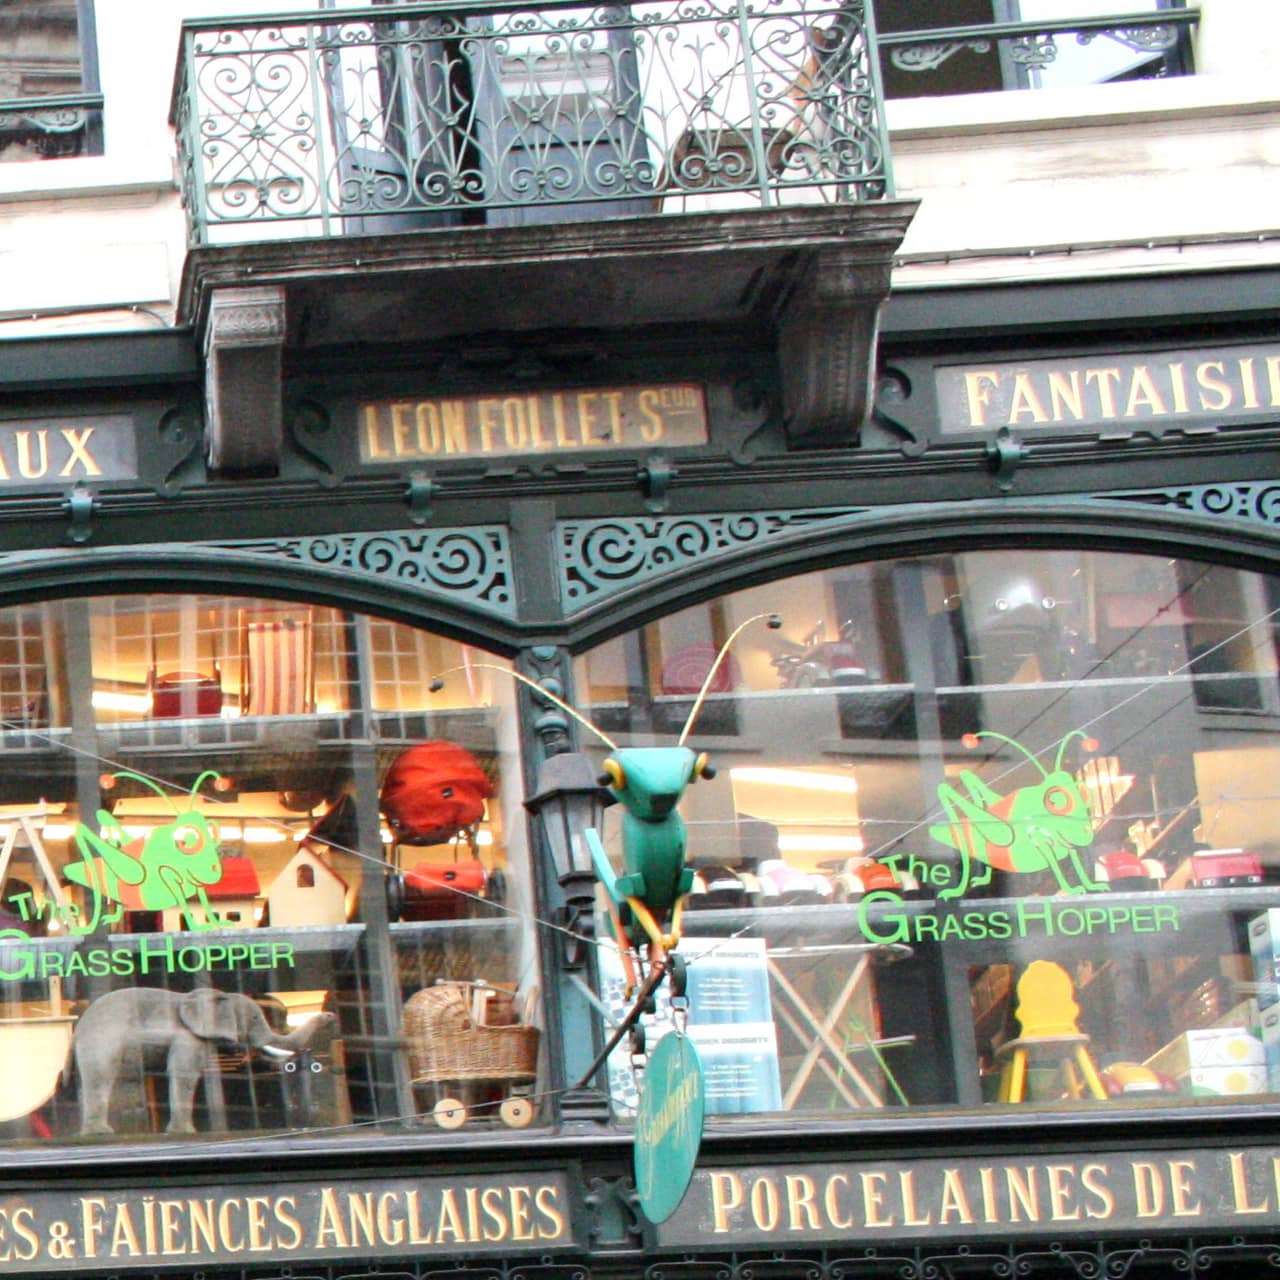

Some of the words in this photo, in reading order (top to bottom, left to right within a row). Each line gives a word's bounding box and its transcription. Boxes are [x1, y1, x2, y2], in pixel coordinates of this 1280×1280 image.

[480, 391, 625, 453] FOLLET
[885, 853, 952, 889] The
[7, 890, 80, 923] The
[48, 1220, 77, 1261] &
[80, 1194, 303, 1260] FAÏENCES
[314, 1185, 565, 1249] ANGLAISES
[711, 1162, 1115, 1234] PORCELAINES
[1131, 1160, 1202, 1218] DE
[1229, 1151, 1280, 1215] L
